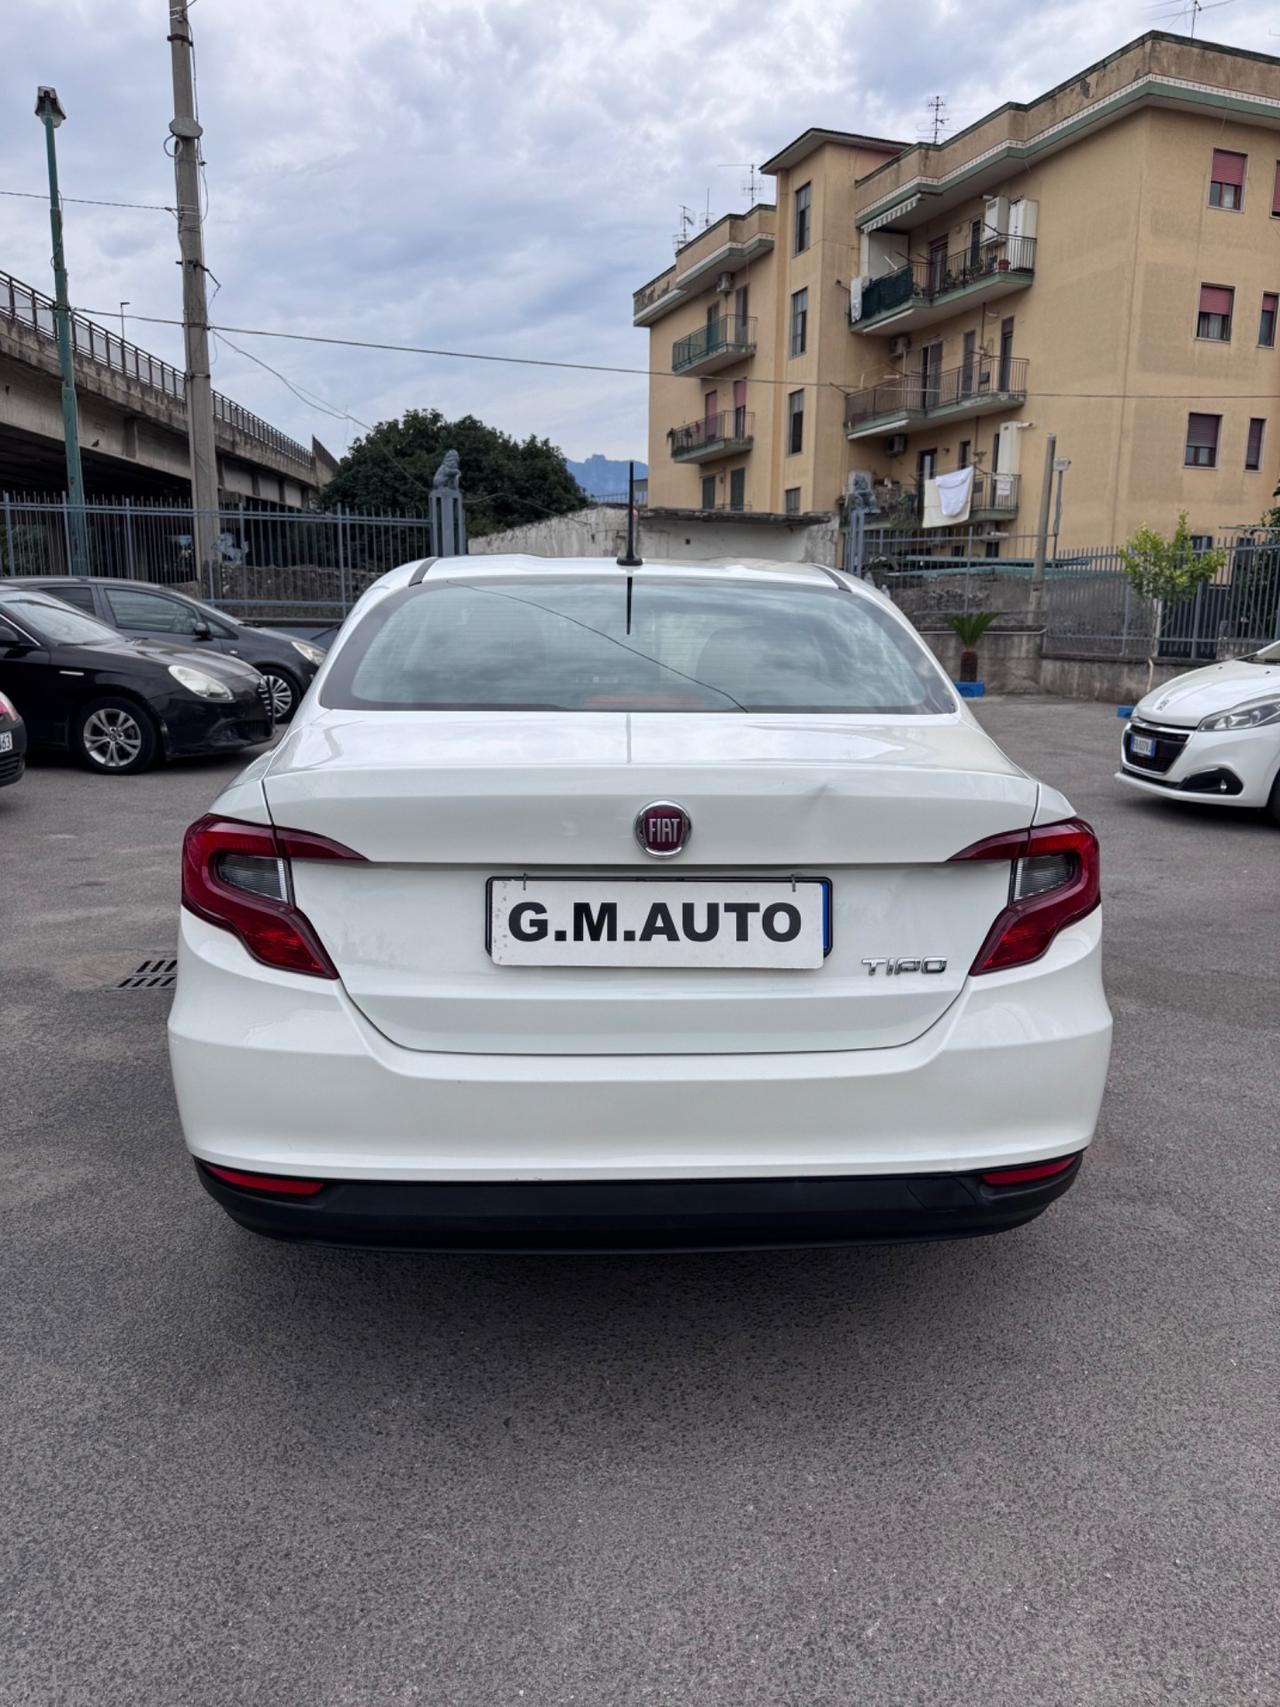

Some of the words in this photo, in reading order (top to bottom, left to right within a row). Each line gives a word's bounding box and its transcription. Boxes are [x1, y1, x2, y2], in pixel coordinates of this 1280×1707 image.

[0, 734, 11, 751] 63
[648, 818, 680, 843] FIAT
[508, 901, 801, 942] G.M.AUTO
[861, 957, 947, 976] TIPO
